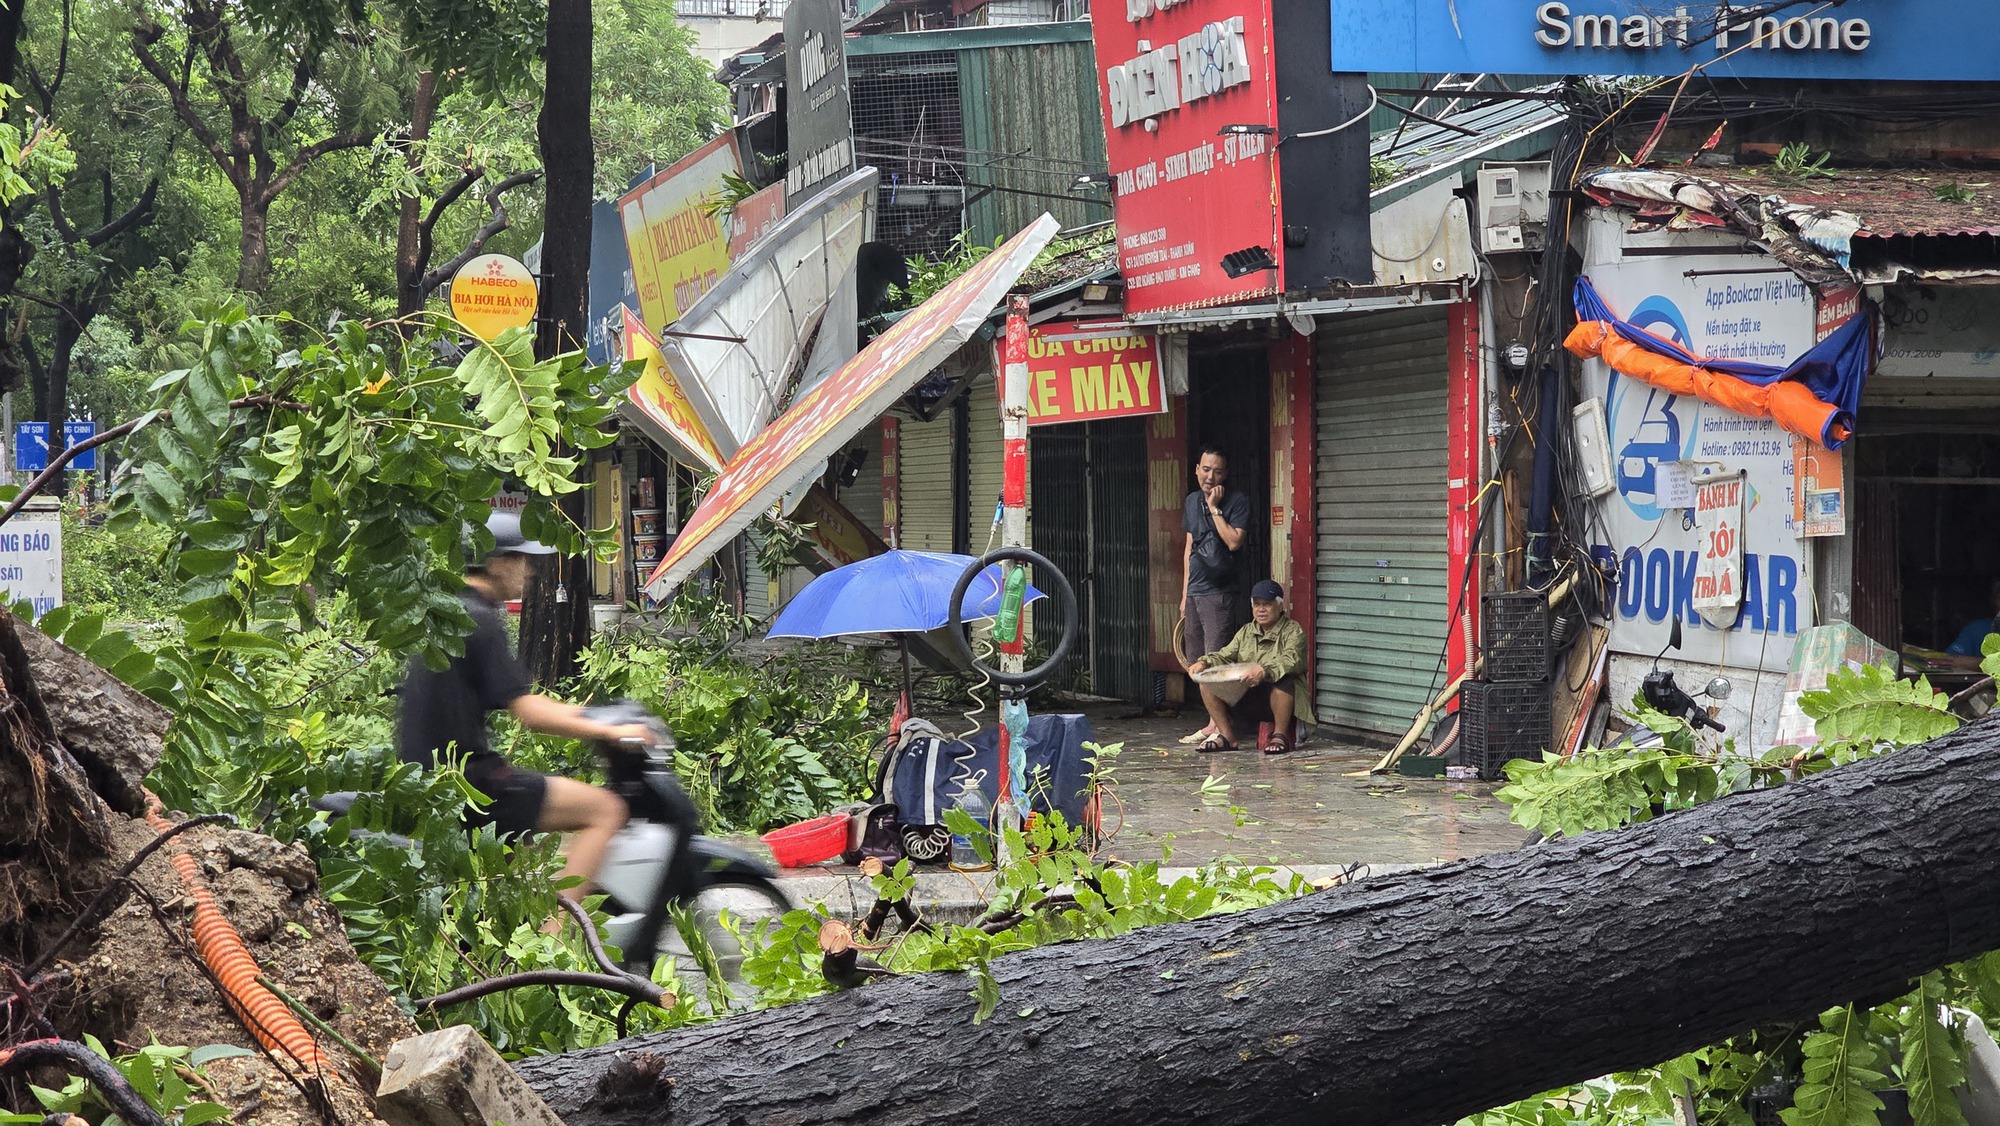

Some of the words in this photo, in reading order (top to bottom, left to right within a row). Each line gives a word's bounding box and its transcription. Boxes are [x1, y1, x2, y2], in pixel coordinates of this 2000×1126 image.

[1534, 1, 1692, 48] Smart
[1716, 4, 1870, 51] Phone
[800, 29, 826, 92] DŨNG
[1107, 40, 1180, 132] ĐIỆN
[1178, 15, 1250, 104] HOA
[1116, 169, 1135, 196] HOA
[1136, 157, 1158, 191] CƯỚI
[1165, 152, 1188, 182] SINH
[1189, 140, 1214, 175] NHẬT
[471, 277, 518, 288] HABECO
[1705, 287, 1724, 310] App
[1726, 283, 1763, 304] Bookcar
[1765, 279, 1783, 306] Việt
[1784, 279, 1806, 299] Nam
[454, 293, 472, 304] BIA
[474, 294, 494, 305] HƠI
[497, 294, 512, 306] HÀ
[514, 295, 534, 310] NỘI
[1815, 302, 1835, 327] IỂM
[1836, 295, 1857, 320] BÁN
[1705, 319, 1720, 336] Nền
[1721, 317, 1738, 337] tảng
[1739, 317, 1751, 337] đặt
[1753, 321, 1761, 333] xe
[1705, 344, 1718, 358] Giá
[1719, 343, 1729, 358] tốt
[1730, 342, 1748, 358] nhất
[1749, 342, 1759, 361] thị
[1760, 342, 1786, 360] trường
[1070, 353, 1152, 413] MÁY
[1703, 417, 1723, 432] Hành
[1742, 418, 1756, 435] trọn
[1701, 441, 1727, 456] Hotline
[1732, 440, 1781, 456] 0982.11.33.96
[23, 529, 50, 552] BÁO
[1590, 544, 1799, 637] BOOKAR
